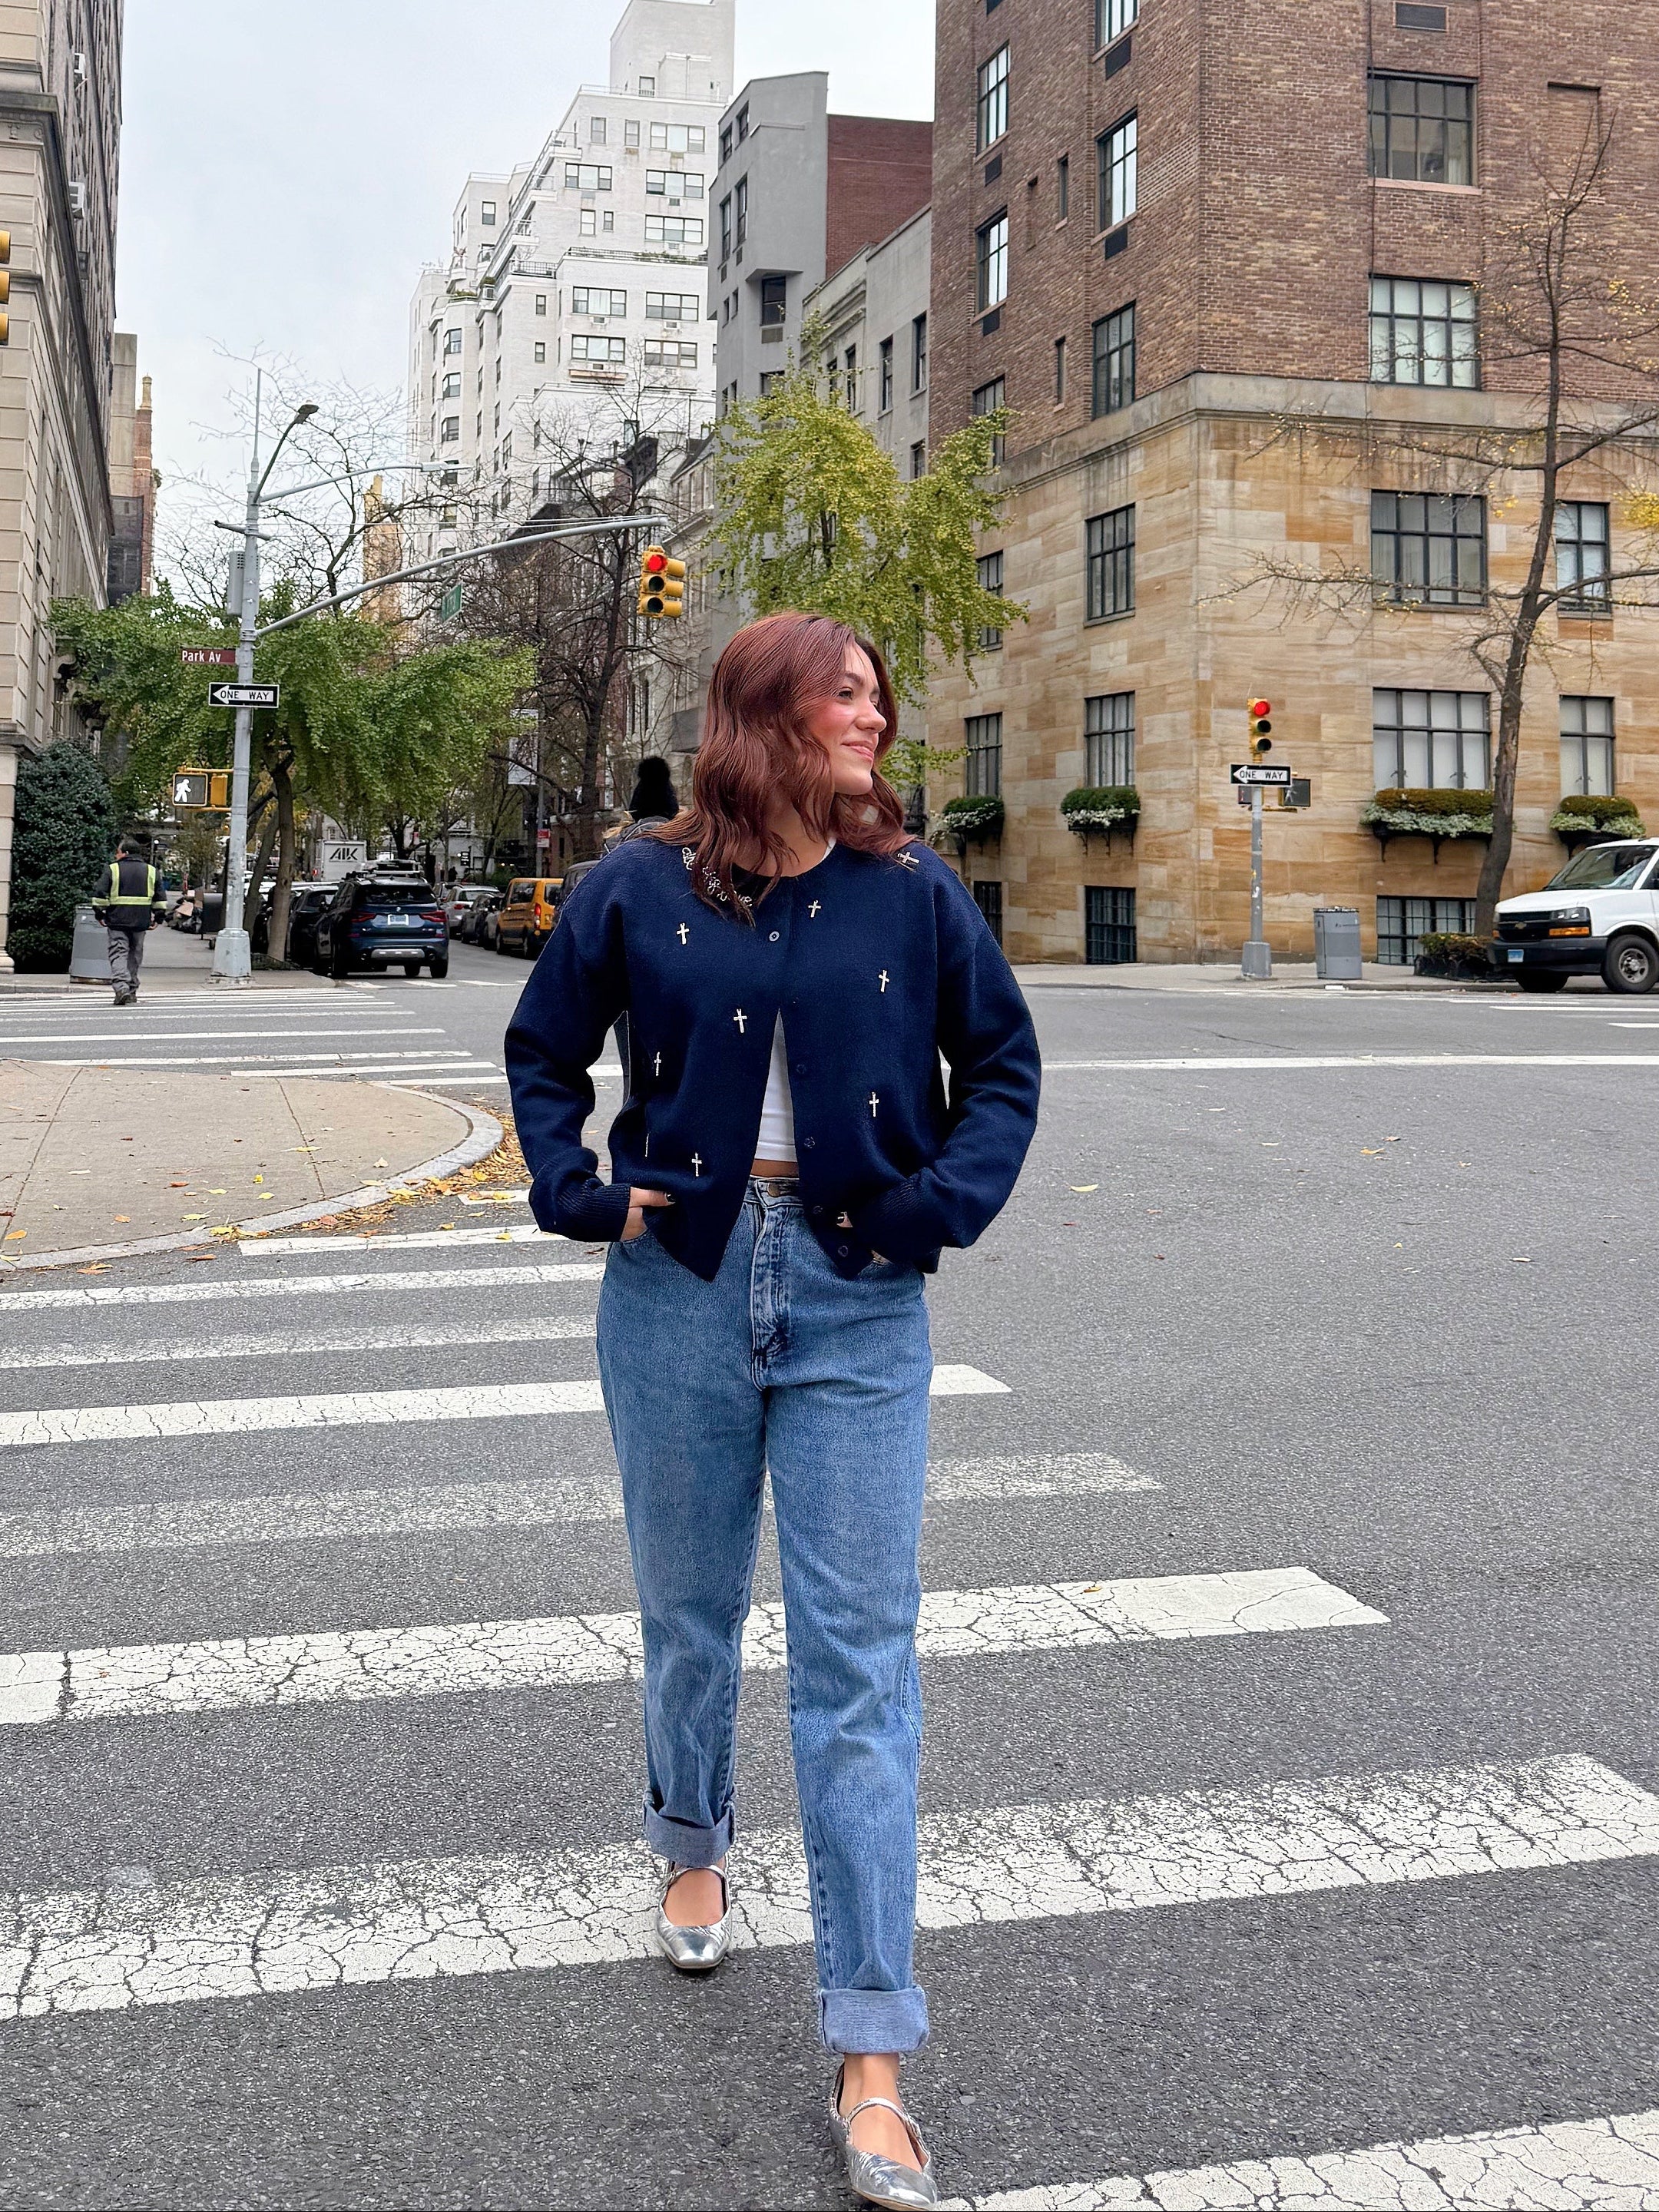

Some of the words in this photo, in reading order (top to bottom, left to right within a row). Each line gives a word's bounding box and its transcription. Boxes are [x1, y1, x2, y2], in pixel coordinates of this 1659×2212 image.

[181, 650, 205, 662] Park
[208, 651, 221, 663] Av
[220, 690, 240, 699] ONE
[249, 692, 270, 700] WAY
[1239, 770, 1257, 779] ONE
[1265, 771, 1283, 780] WAY
